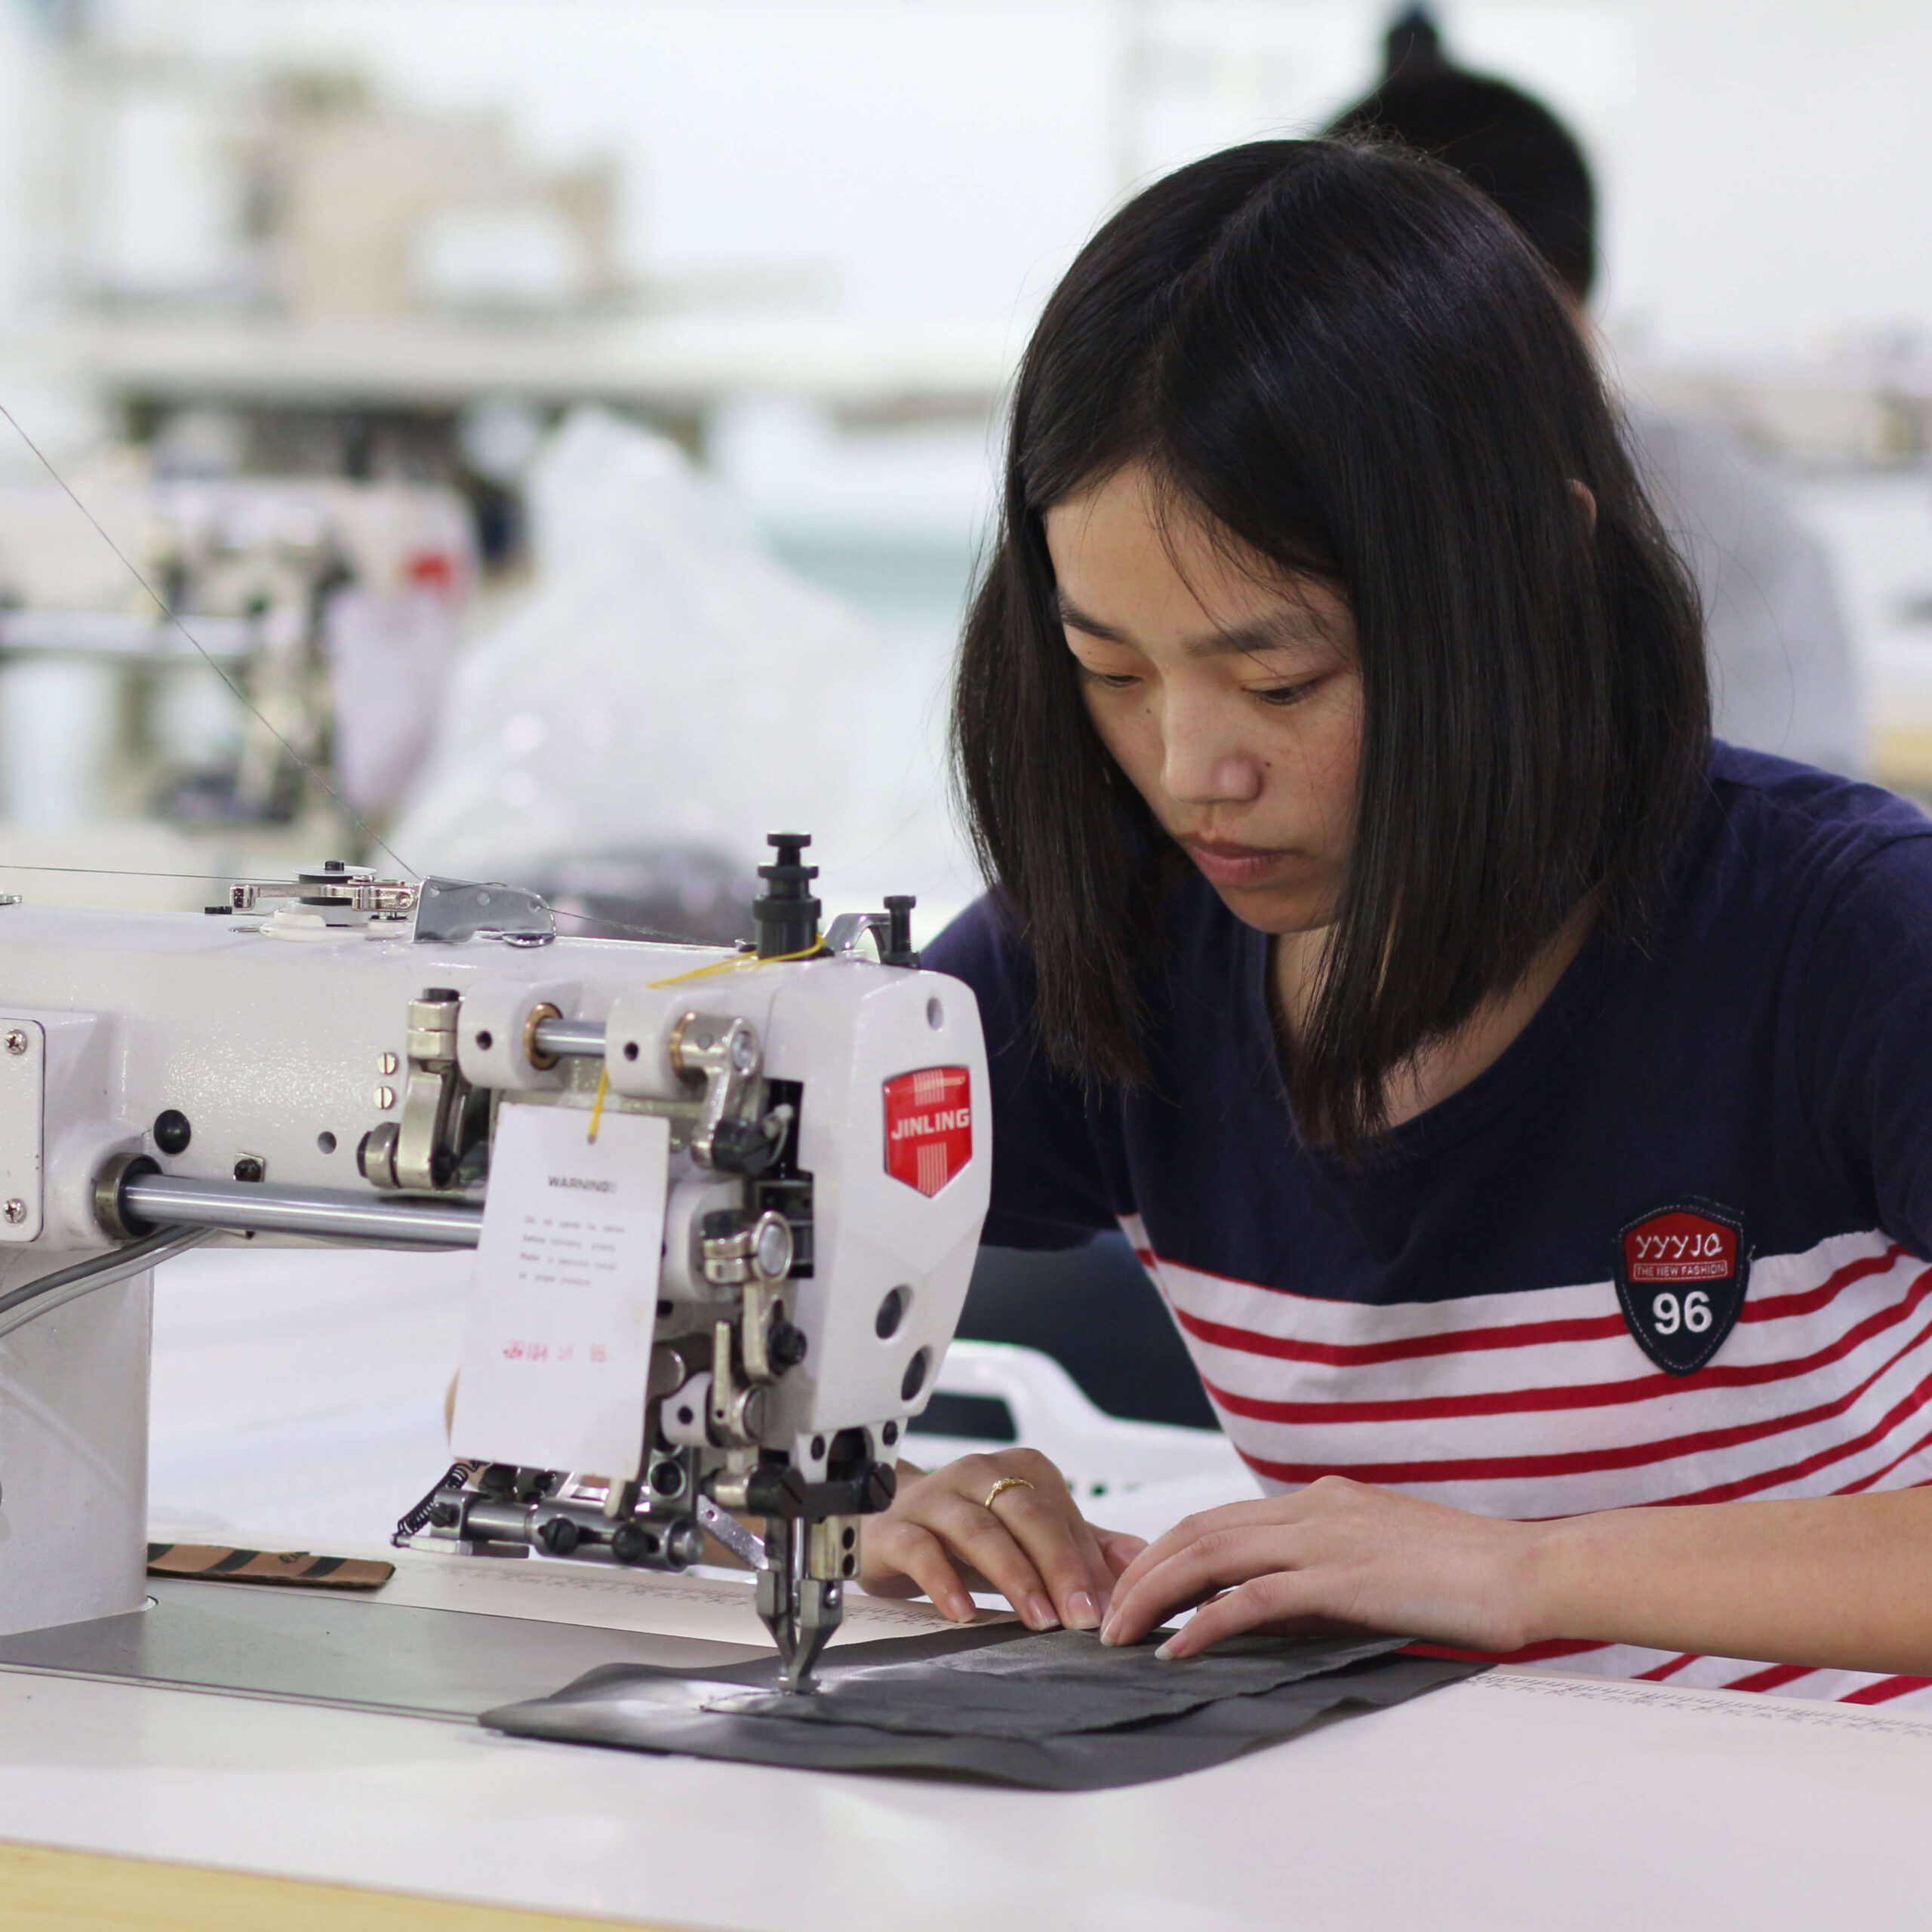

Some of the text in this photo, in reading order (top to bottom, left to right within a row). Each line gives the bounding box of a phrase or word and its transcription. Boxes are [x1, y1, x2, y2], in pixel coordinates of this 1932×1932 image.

[891, 1107, 971, 1141] JINLING
[1636, 1263, 1725, 1277] THE NEW FASHION
[1652, 1291, 1713, 1335] 96
